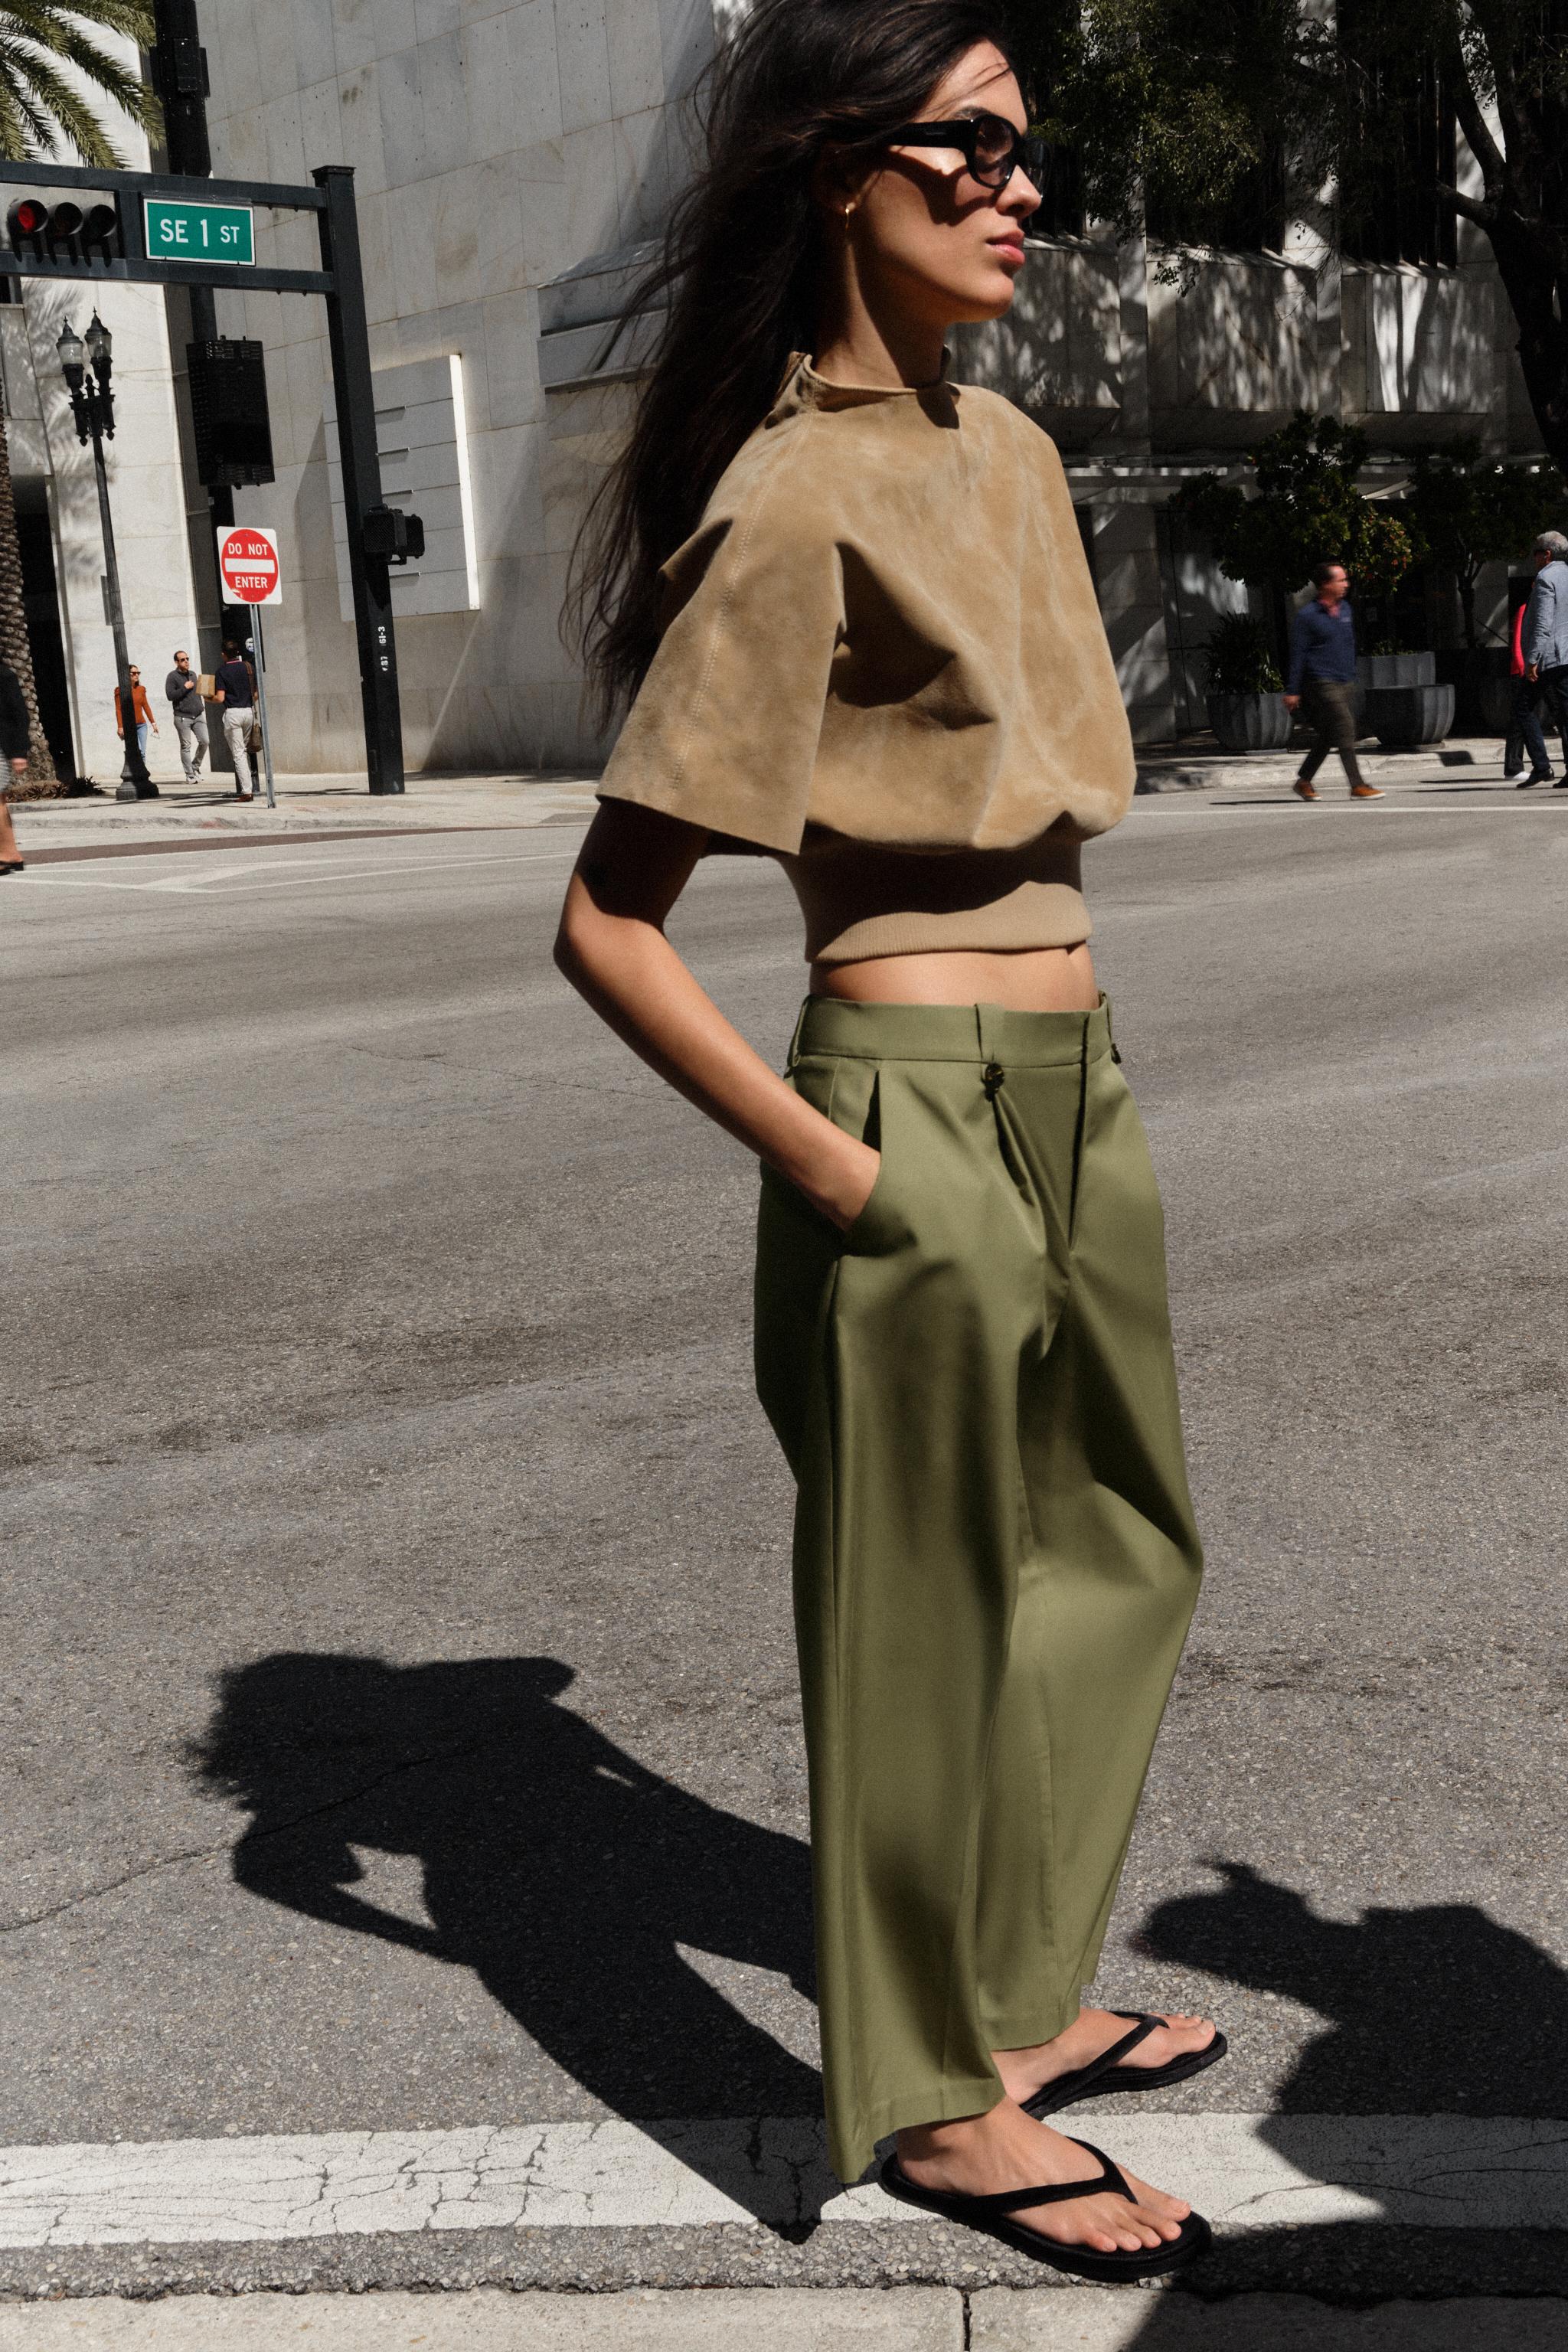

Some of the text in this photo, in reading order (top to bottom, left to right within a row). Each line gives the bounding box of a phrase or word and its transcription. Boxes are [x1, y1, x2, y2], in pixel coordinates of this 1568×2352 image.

[160, 218, 240, 247] SE 1 ST
[227, 543, 268, 556] DO NOT
[234, 576, 268, 589] ENTER
